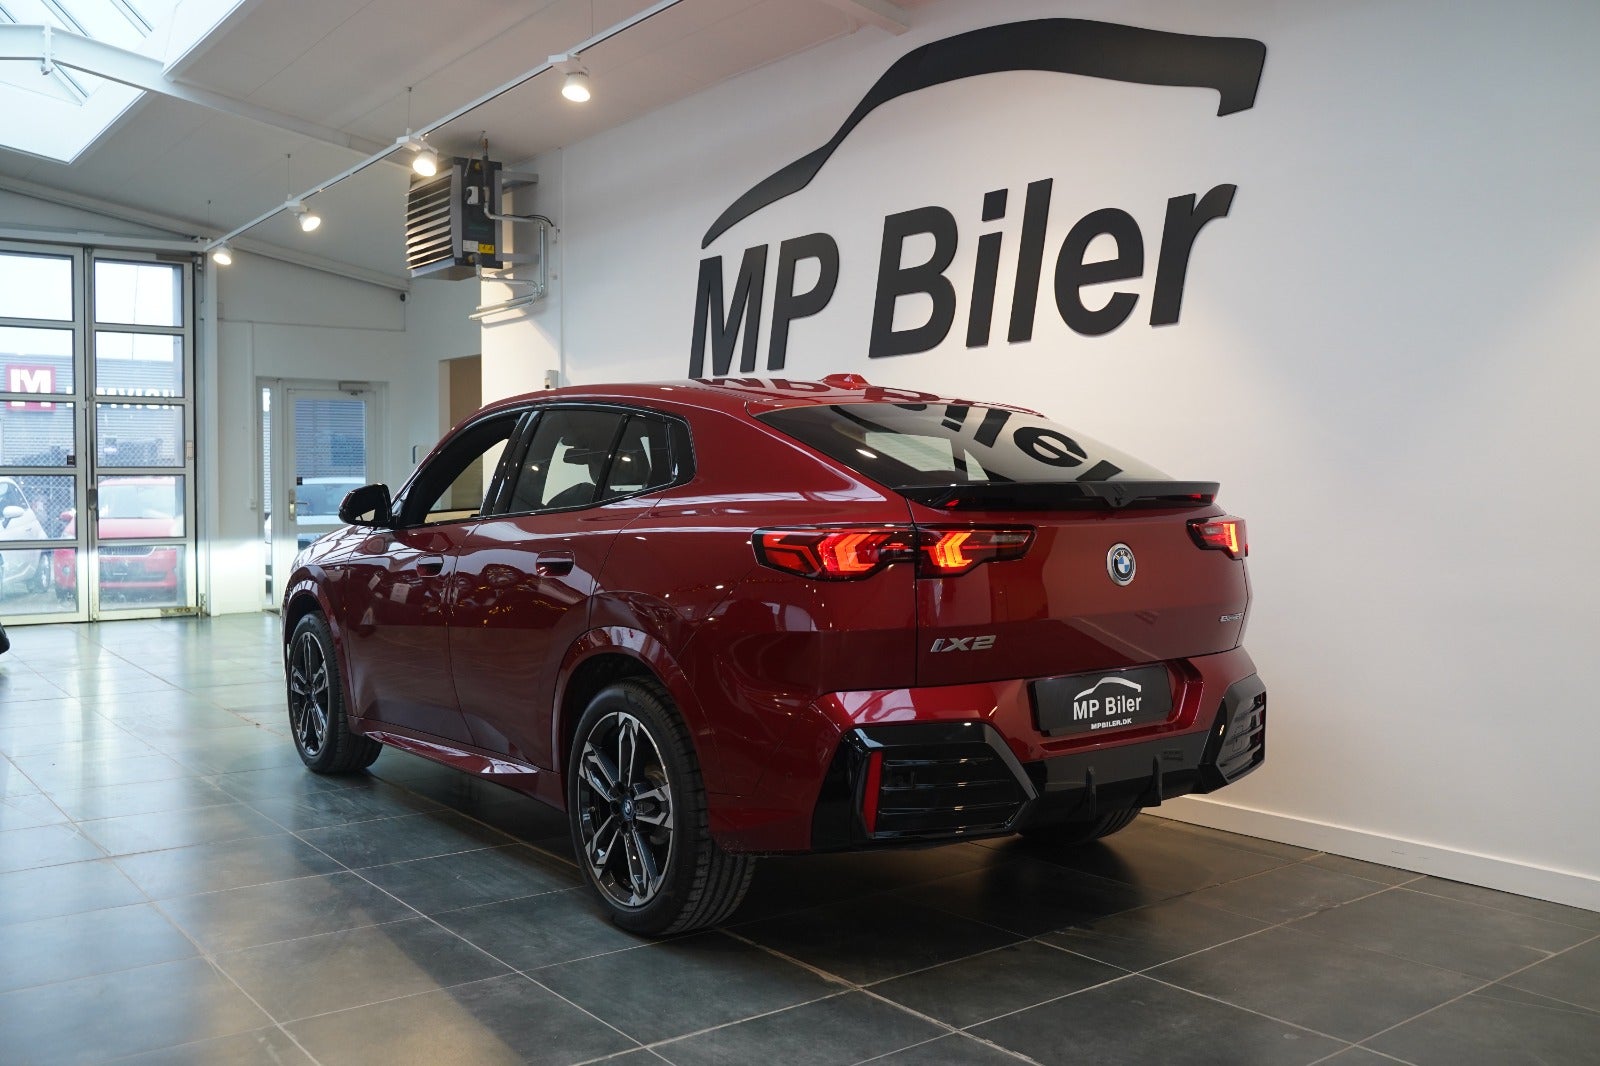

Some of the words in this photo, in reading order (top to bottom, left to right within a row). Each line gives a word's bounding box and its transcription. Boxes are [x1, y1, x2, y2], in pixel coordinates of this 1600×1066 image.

[688, 232, 840, 381] MP
[868, 178, 1237, 358] Biler
[1073, 699, 1100, 720] MP
[1105, 695, 1142, 716] Biler
[1090, 717, 1133, 730] MPBILER.DK
